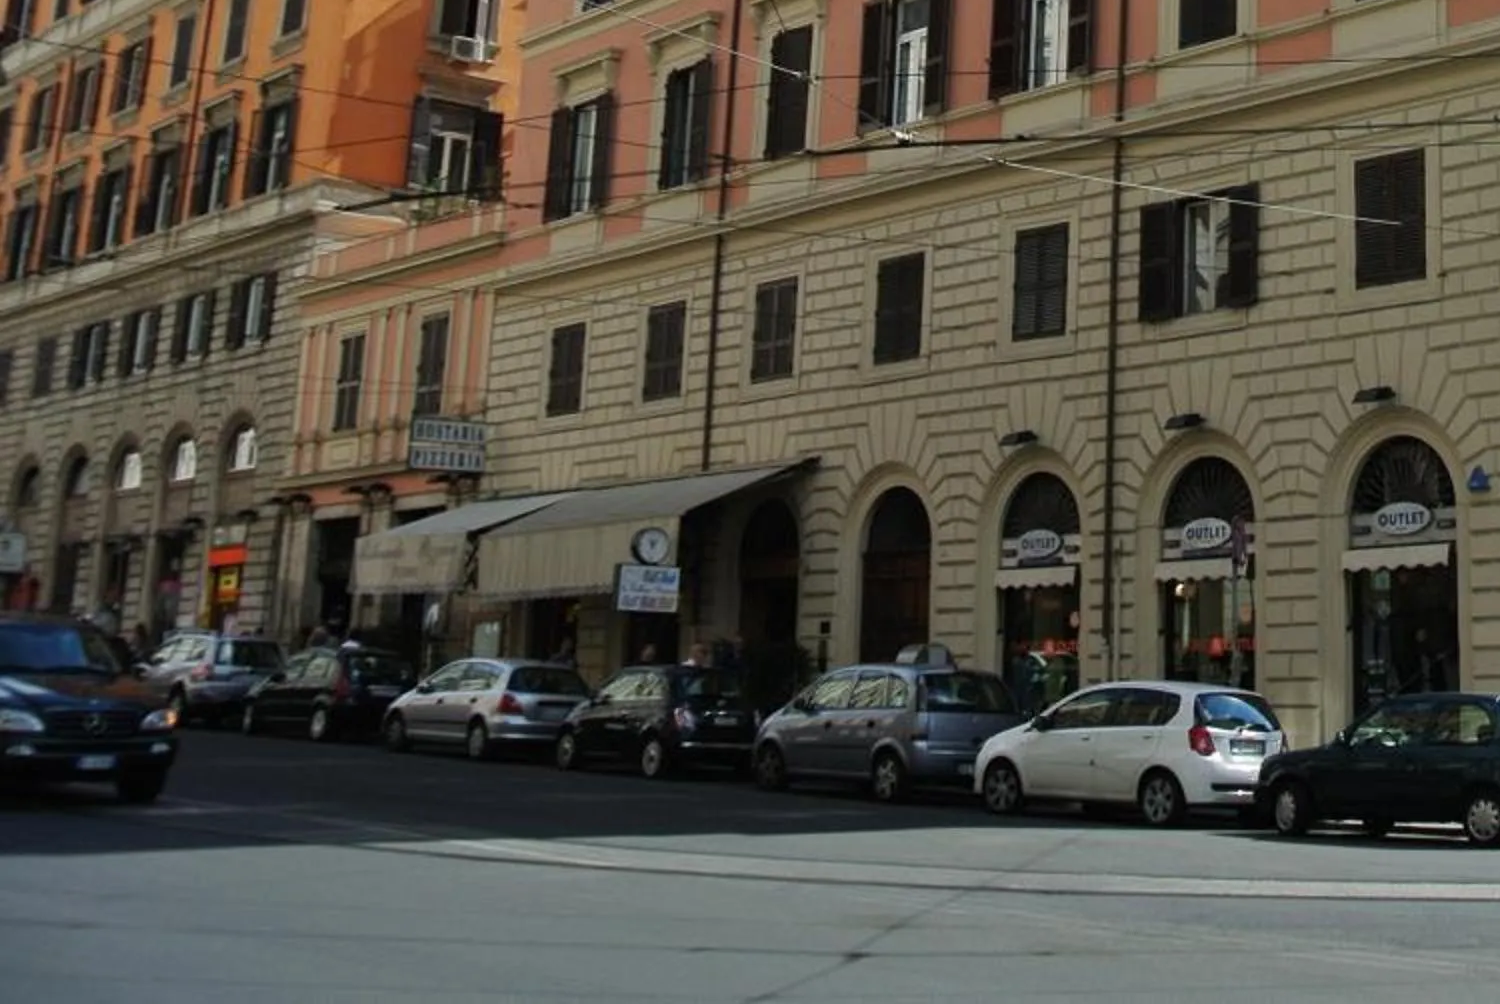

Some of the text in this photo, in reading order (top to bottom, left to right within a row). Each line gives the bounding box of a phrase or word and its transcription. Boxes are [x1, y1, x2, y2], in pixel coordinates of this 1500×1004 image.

[413, 449, 482, 468] PIZZERIA
[1377, 510, 1425, 527] OUTLET
[1186, 525, 1226, 540] OUTLET
[1021, 537, 1056, 550] OUTLET
